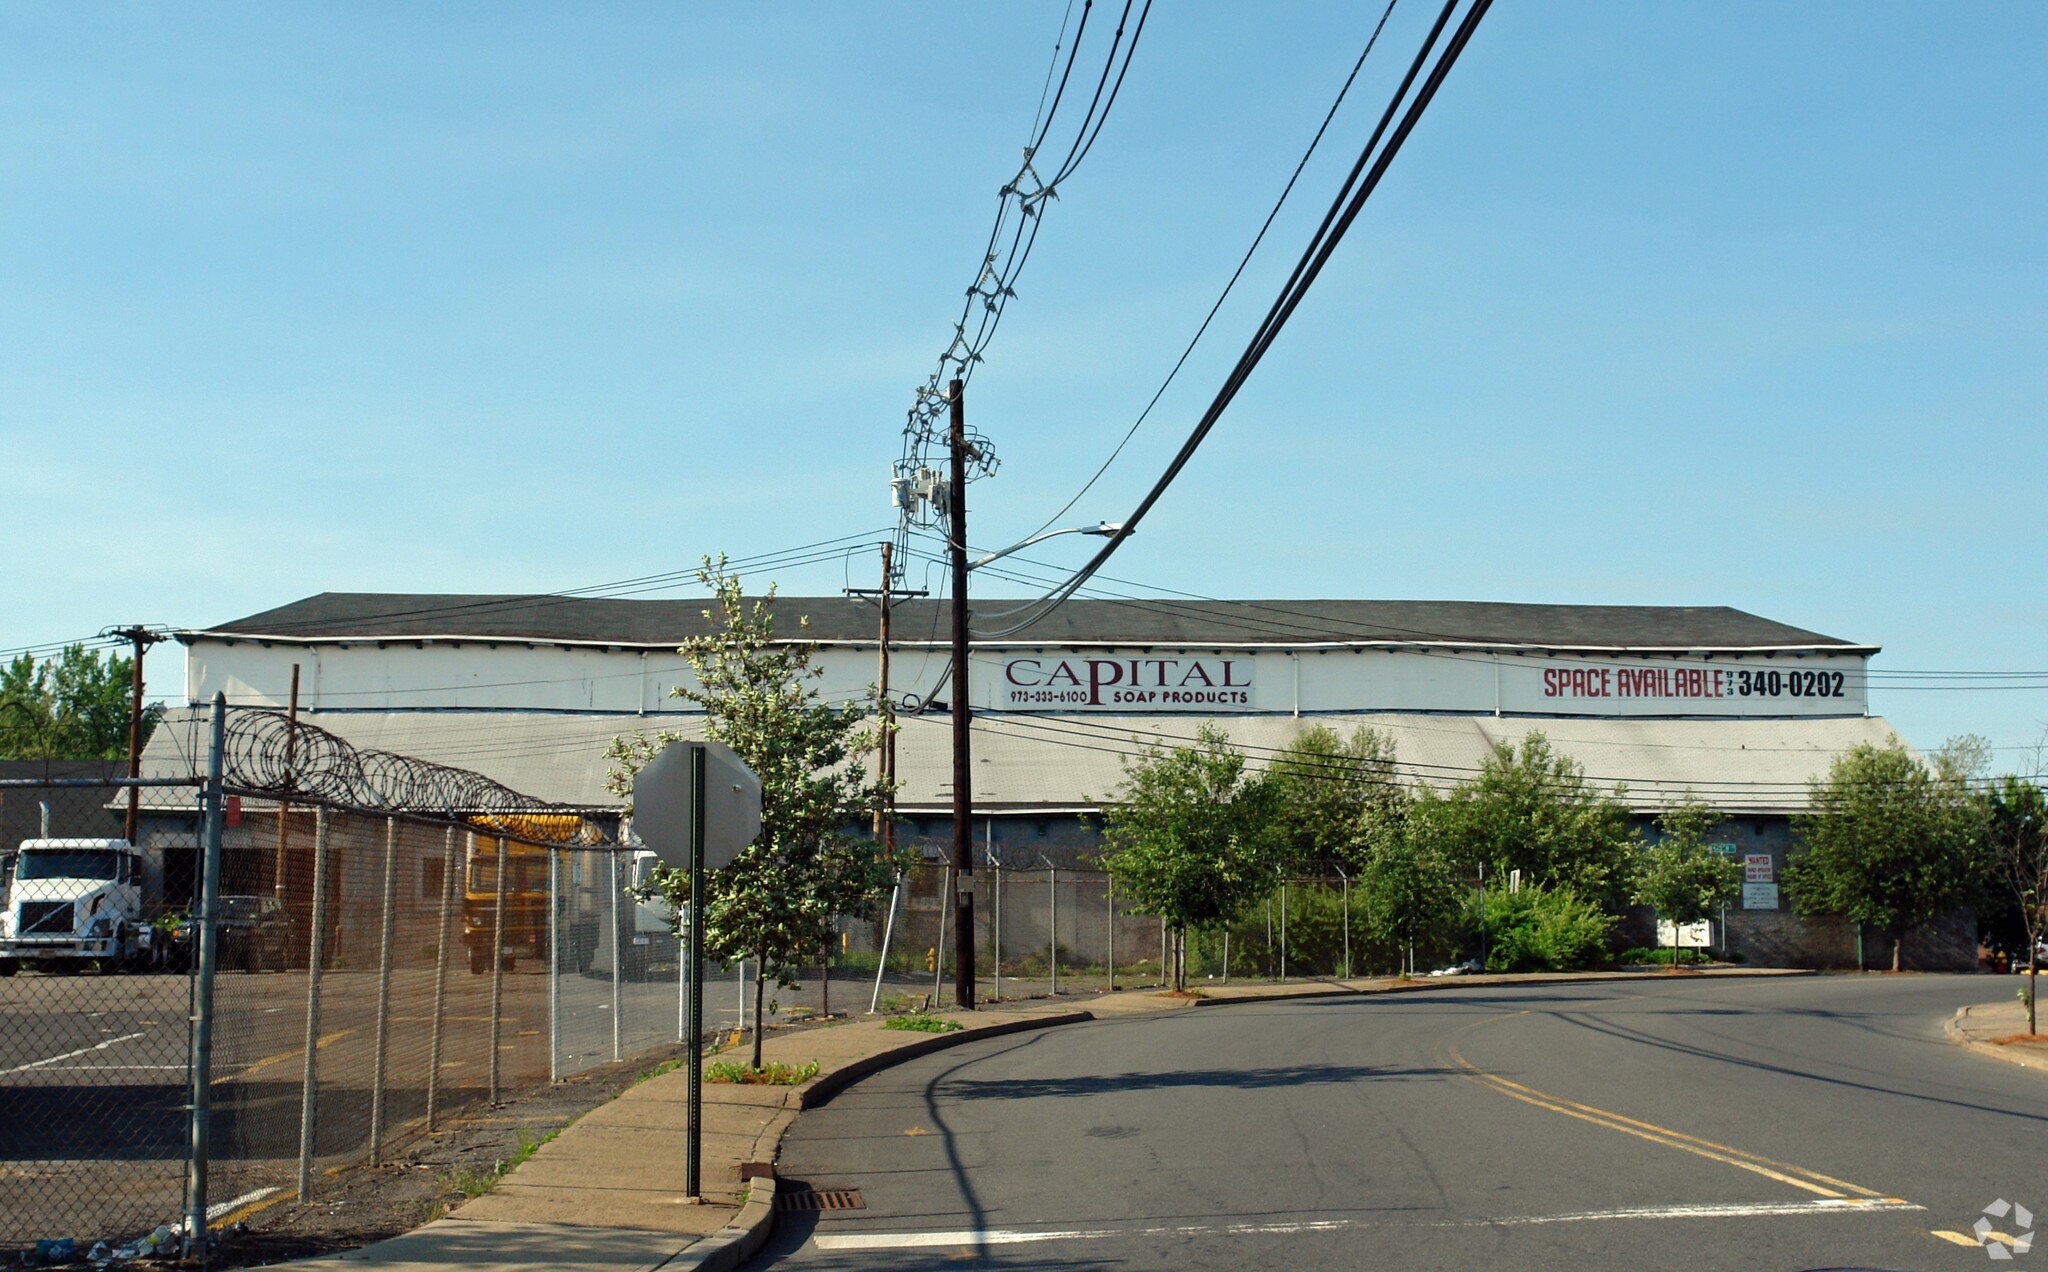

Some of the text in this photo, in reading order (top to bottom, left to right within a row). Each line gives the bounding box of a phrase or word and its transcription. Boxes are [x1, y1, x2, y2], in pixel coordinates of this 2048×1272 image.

[1005, 659, 1252, 705] CAPITAL
[1544, 668, 1611, 697] SPACE
[1618, 668, 1723, 698] AVAILABLE
[1738, 670, 1845, 697] 340-0202
[1010, 690, 1087, 703] 973-333-6100
[1113, 690, 1248, 703] SOAP PRODUCTS
[1748, 856, 1769, 865] WANTED
